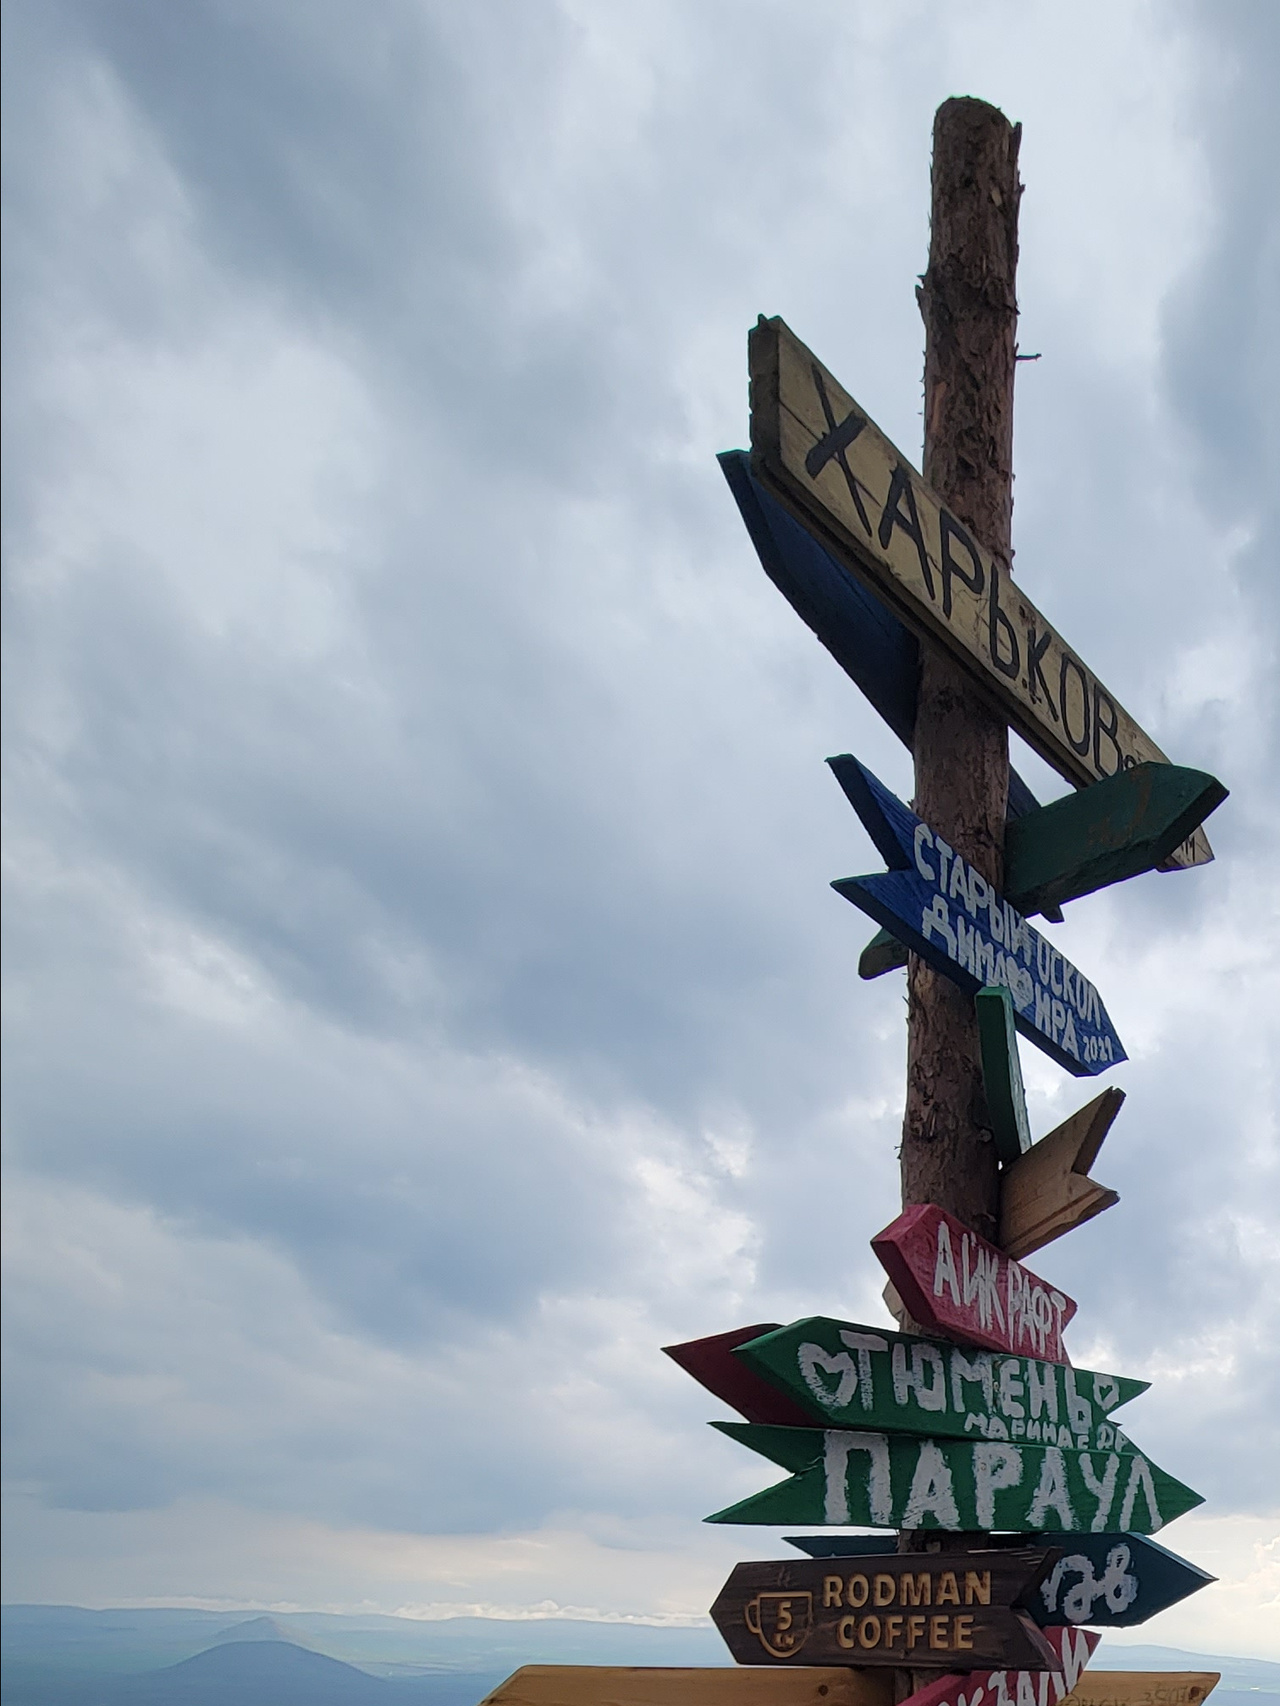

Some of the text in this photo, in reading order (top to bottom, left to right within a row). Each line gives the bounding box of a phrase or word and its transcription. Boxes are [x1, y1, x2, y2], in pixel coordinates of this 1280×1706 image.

[804, 362, 1123, 778] ХАРЬКОВ
[922, 894, 1009, 987] ДИМА
[1034, 982, 1080, 1060] ИРА
[1036, 934, 1102, 1029] ОСКОЛ
[839, 1329, 1093, 1434] ТЮМЕНЬ
[823, 1429, 1163, 1532] ПАРАУЛ
[776, 1601, 793, 1631] 5
[822, 1570, 992, 1608] RODMAN
[837, 1614, 976, 1649] COFFEE
